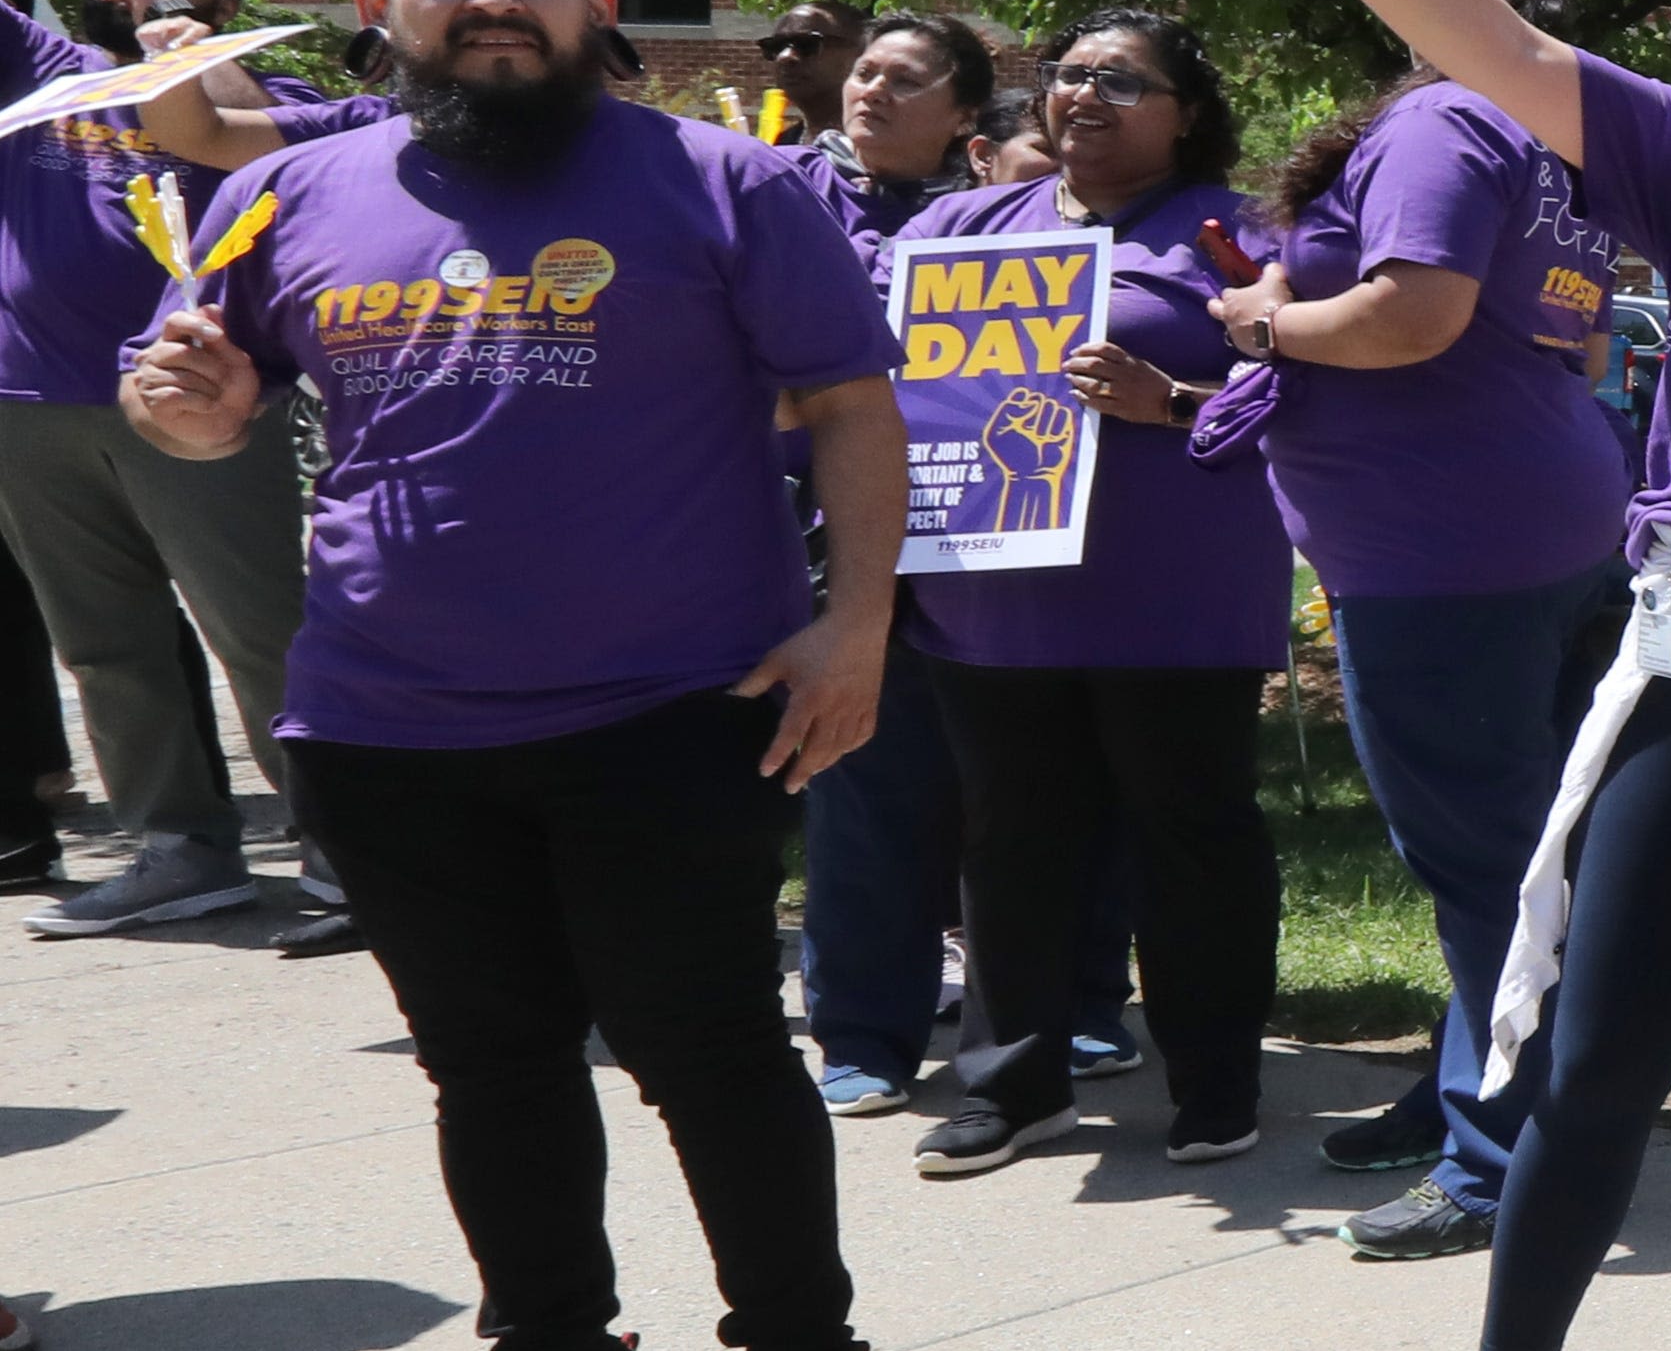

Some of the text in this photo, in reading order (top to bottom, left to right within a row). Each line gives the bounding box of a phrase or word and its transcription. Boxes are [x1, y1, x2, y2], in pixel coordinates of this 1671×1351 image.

[911, 254, 1089, 314] MAY
[471, 316, 547, 333] Workers
[554, 316, 596, 333] East
[438, 345, 518, 365] CARE
[521, 345, 597, 366] AND
[902, 314, 1085, 381] DAY
[469, 367, 526, 386] FOR
[536, 369, 593, 388] ALL
[932, 442, 961, 462] JOB
[963, 441, 980, 461] IS
[968, 464, 985, 483] &
[944, 487, 964, 506] OF
[937, 538, 1005, 552] 1199SEIU
